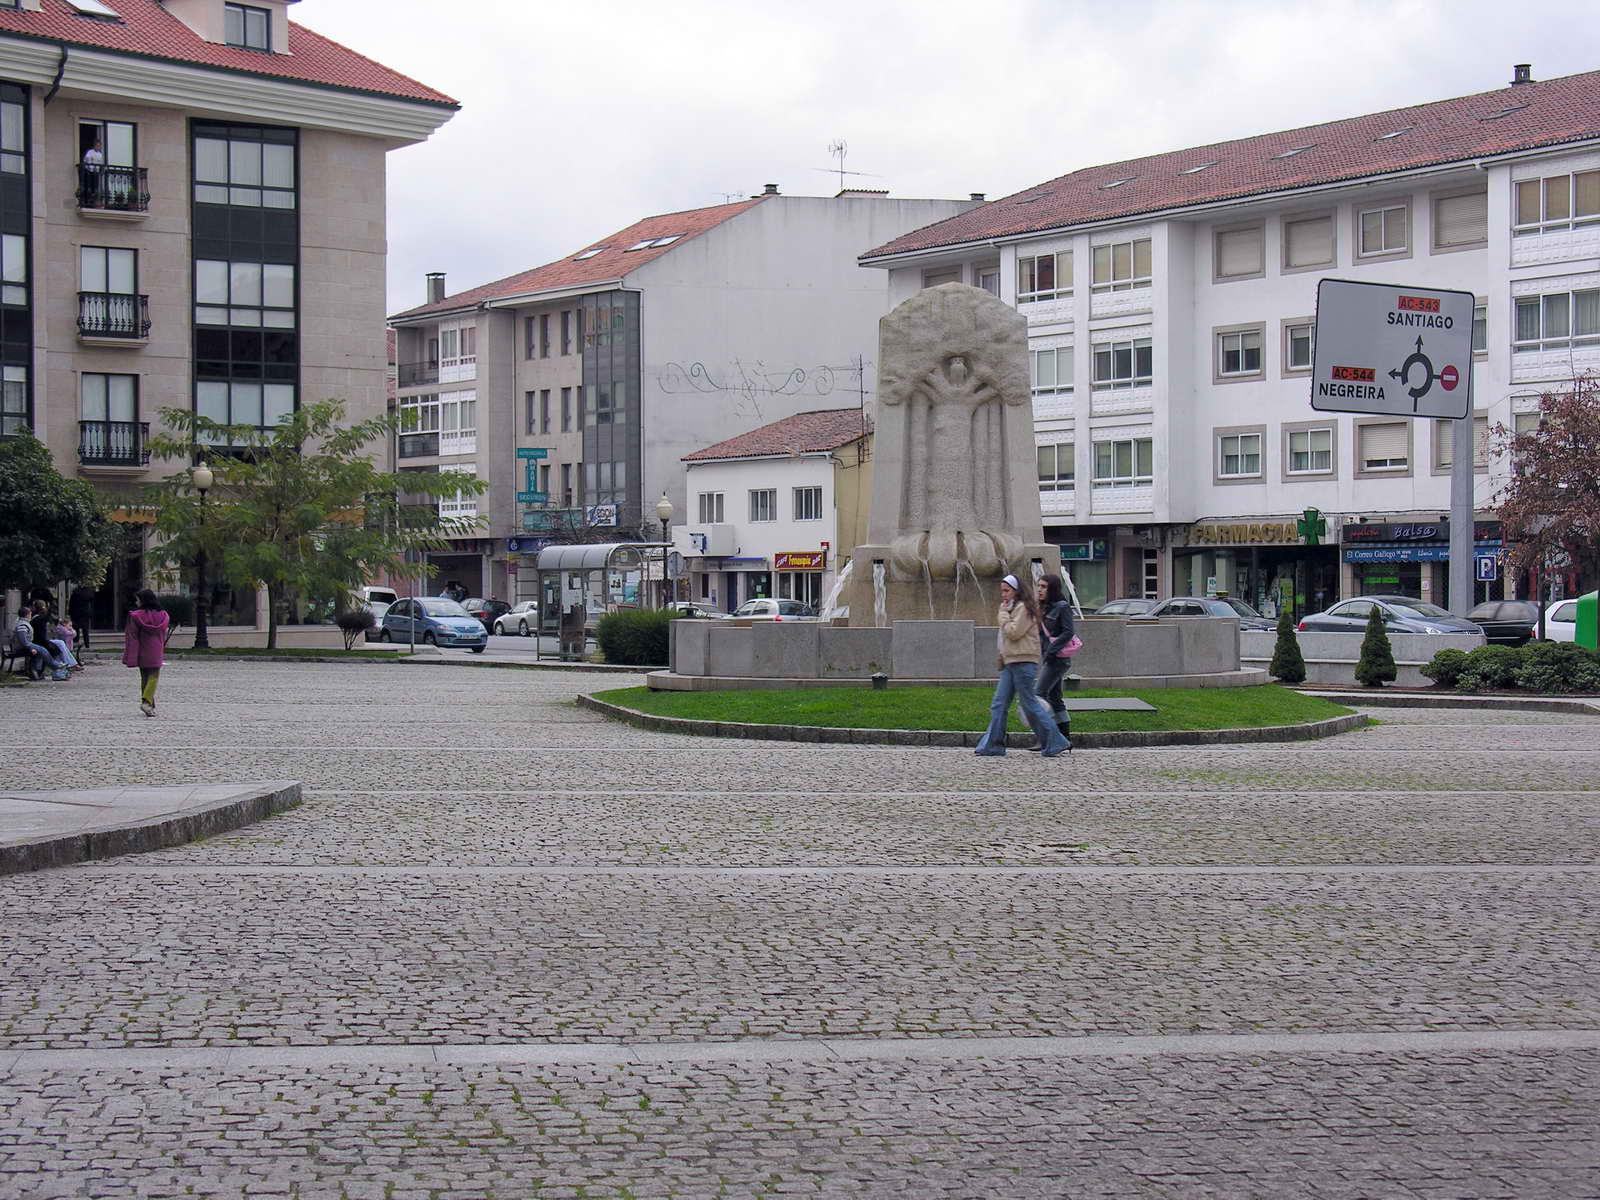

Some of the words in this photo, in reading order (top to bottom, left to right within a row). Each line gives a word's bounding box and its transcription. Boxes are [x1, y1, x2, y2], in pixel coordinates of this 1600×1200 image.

[1399, 297, 1440, 312] AC-543
[1387, 312, 1453, 329] SANTIAGO
[1333, 367, 1376, 382] AC-544
[1319, 383, 1386, 400] NEGREIRA
[1190, 523, 1298, 544] FARMACIA
[1480, 558, 1492, 578] P
